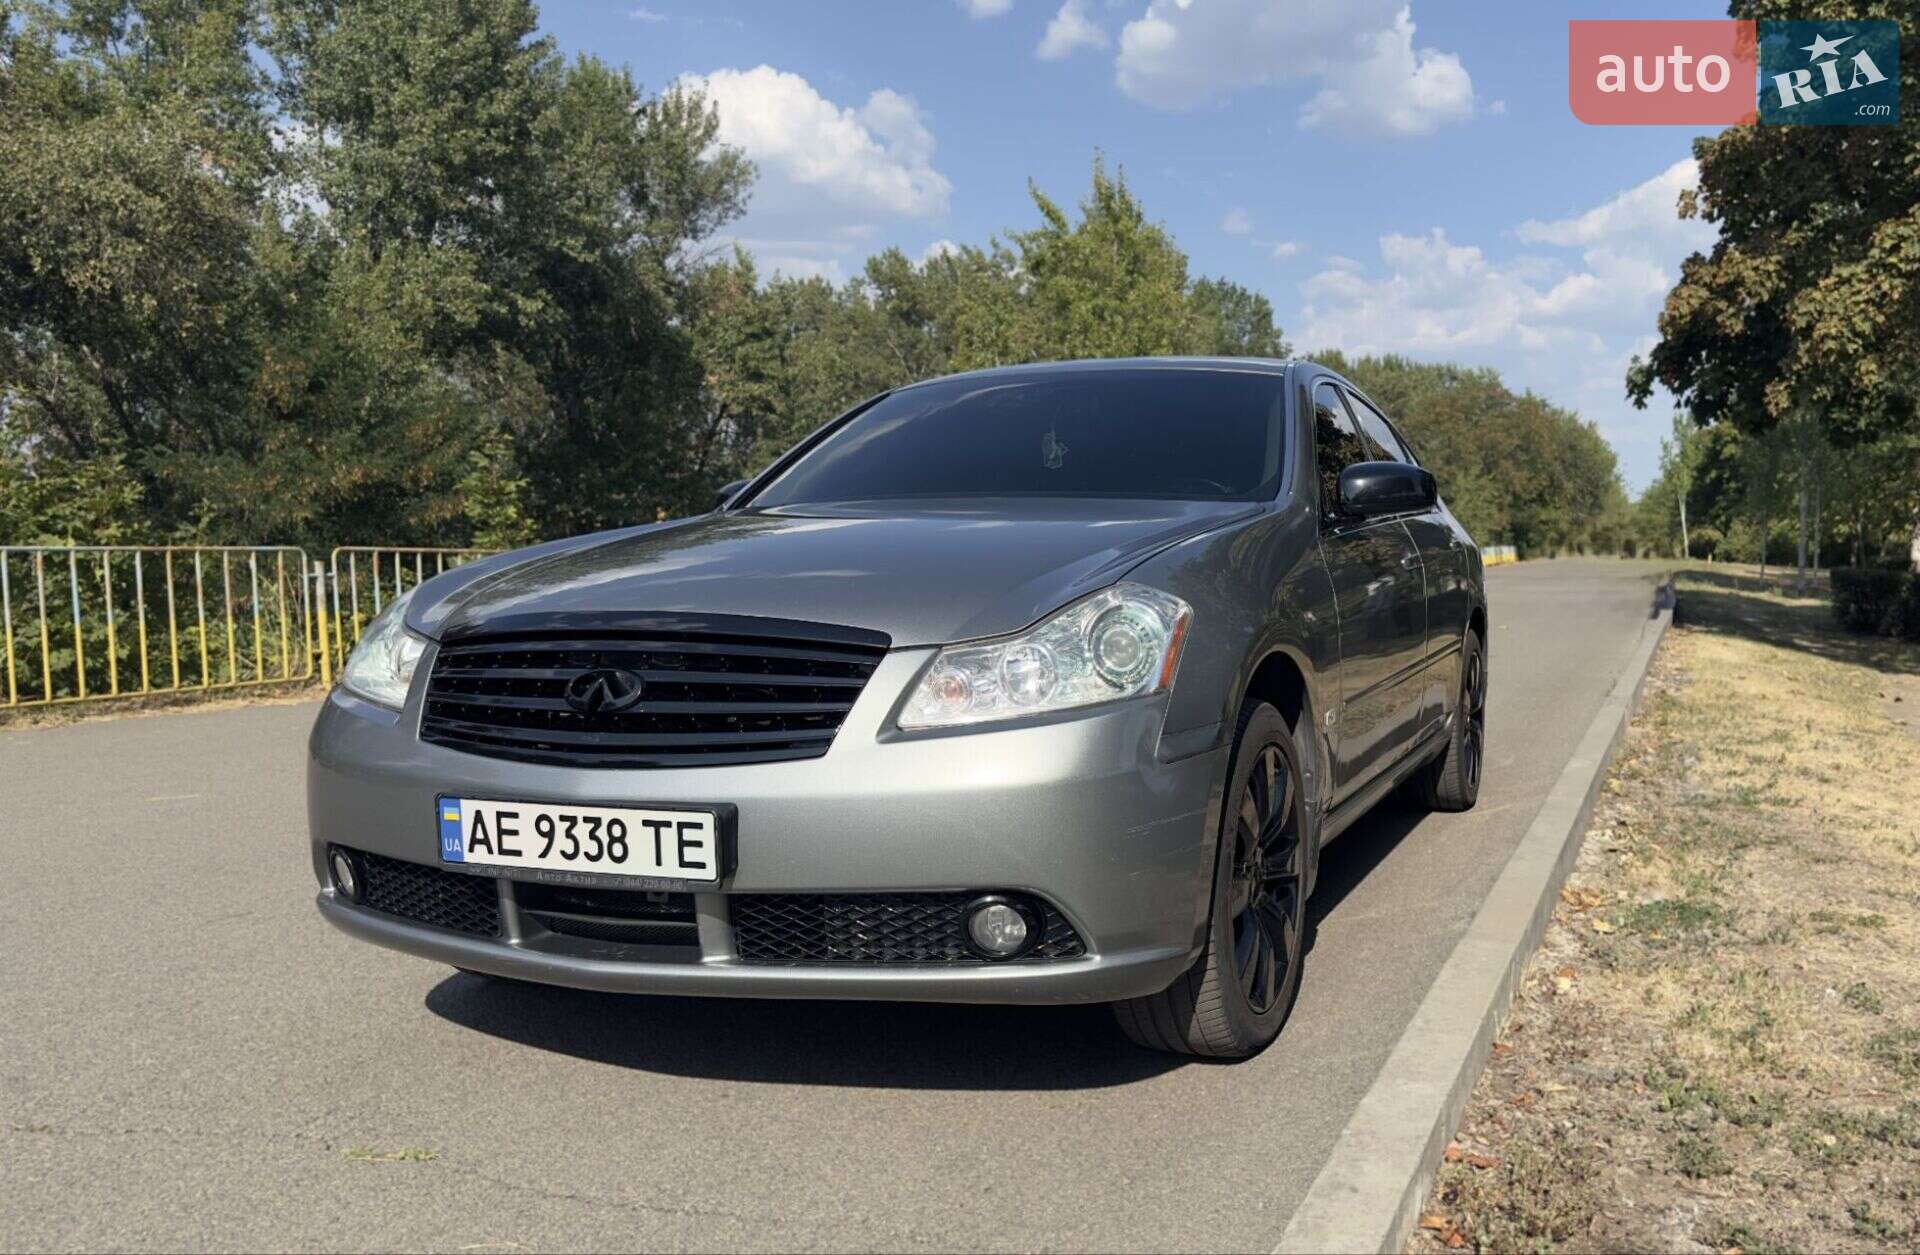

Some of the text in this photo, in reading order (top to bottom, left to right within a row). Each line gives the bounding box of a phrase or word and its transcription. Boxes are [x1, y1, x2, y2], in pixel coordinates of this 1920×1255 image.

[444, 837, 462, 852] UA
[467, 809, 707, 870] AE 9338 TE
